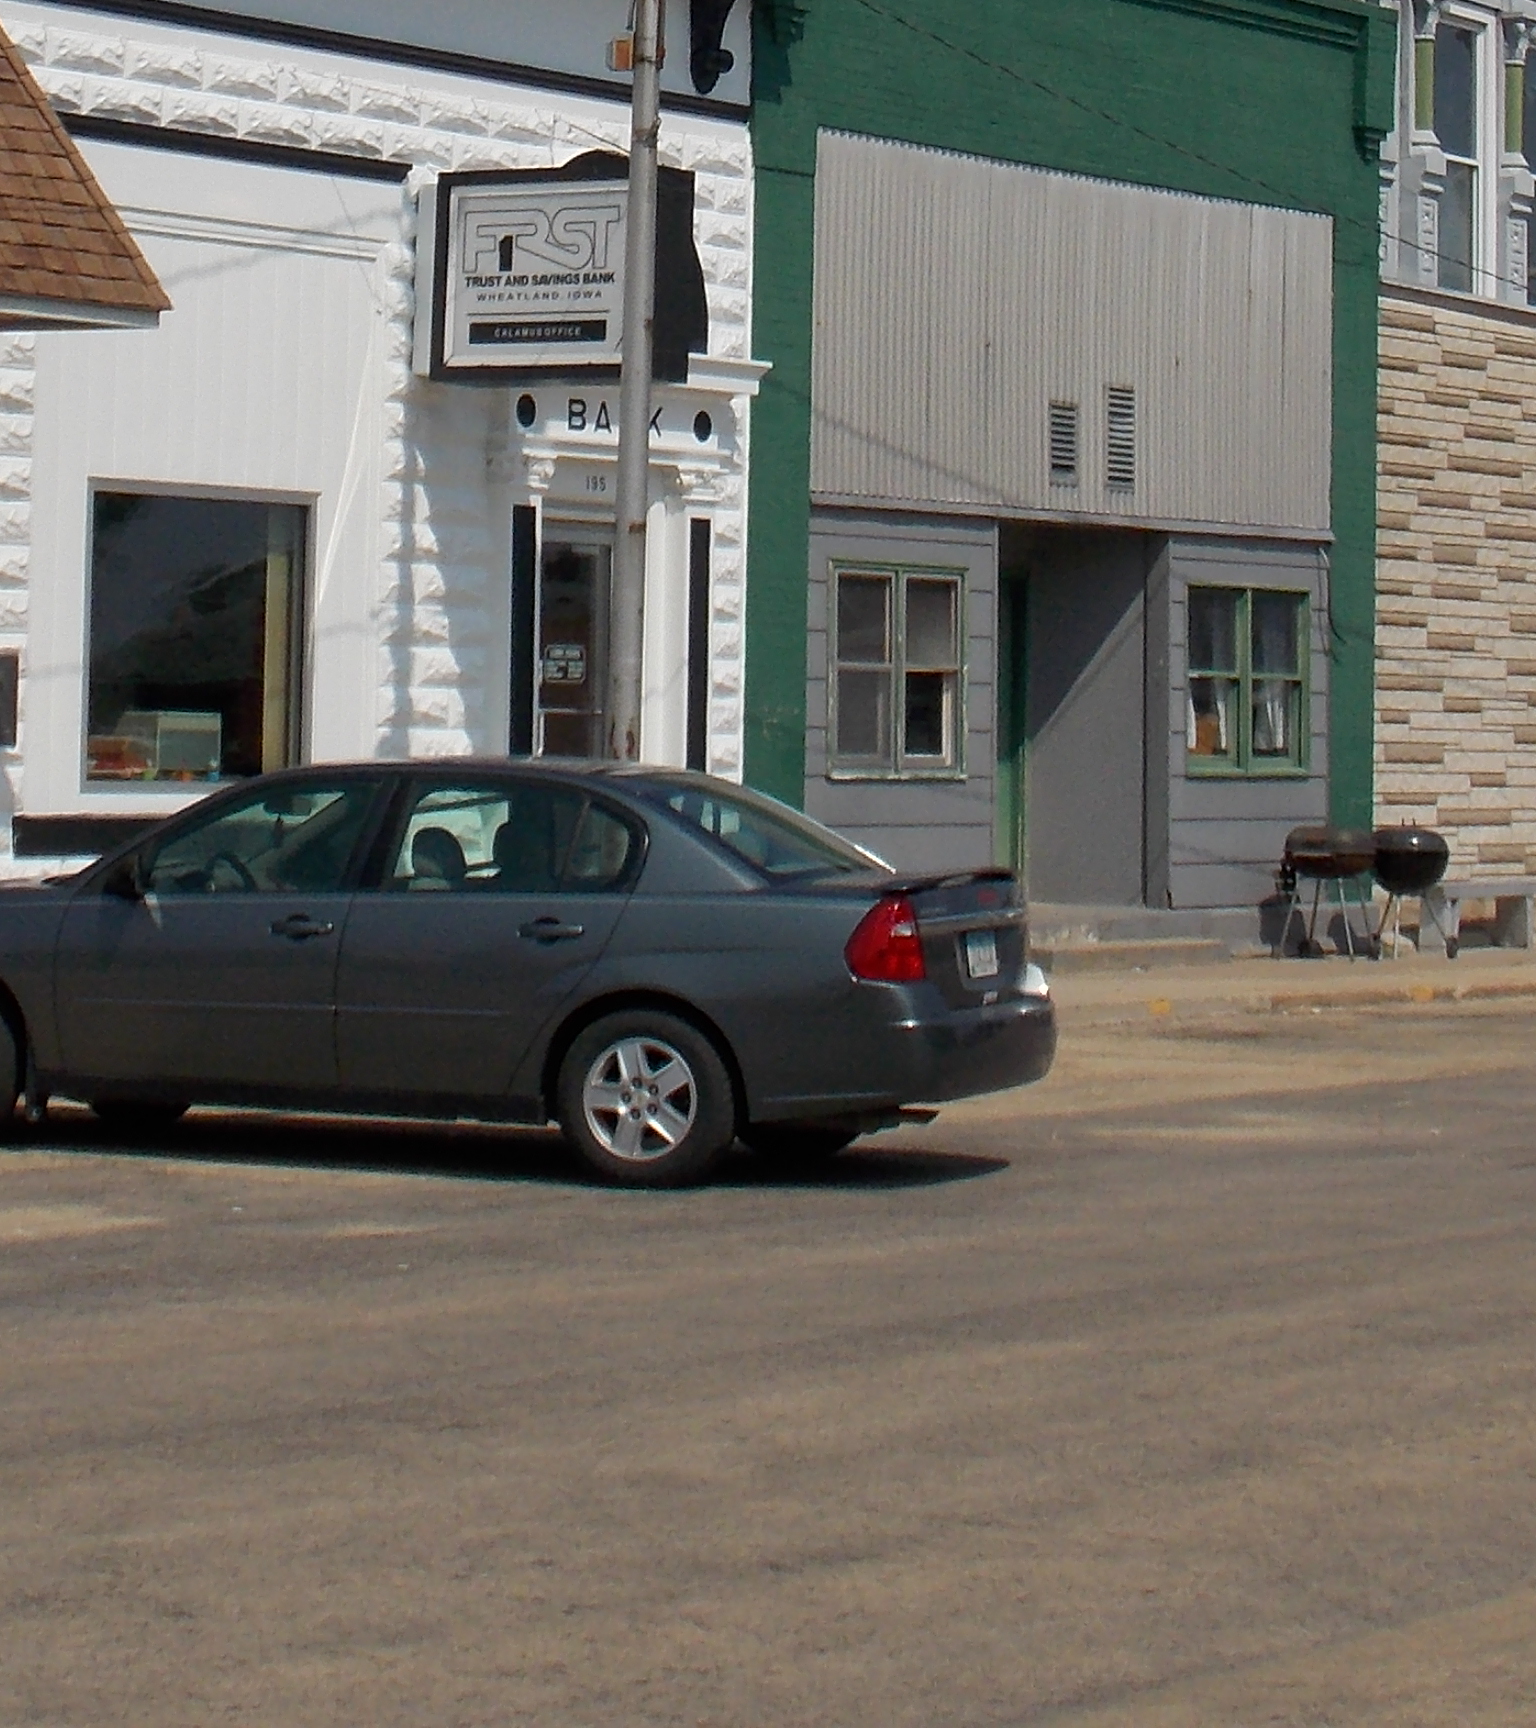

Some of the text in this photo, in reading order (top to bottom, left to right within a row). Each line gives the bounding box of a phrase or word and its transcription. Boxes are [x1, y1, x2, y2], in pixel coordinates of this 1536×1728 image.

[465, 272, 616, 287] TRUST AND SAVINGS BANK
[476, 291, 603, 302] WHEATLAND IOWA
[494, 325, 582, 338] CALAMUS OFFICE
[568, 398, 663, 438] BAK
